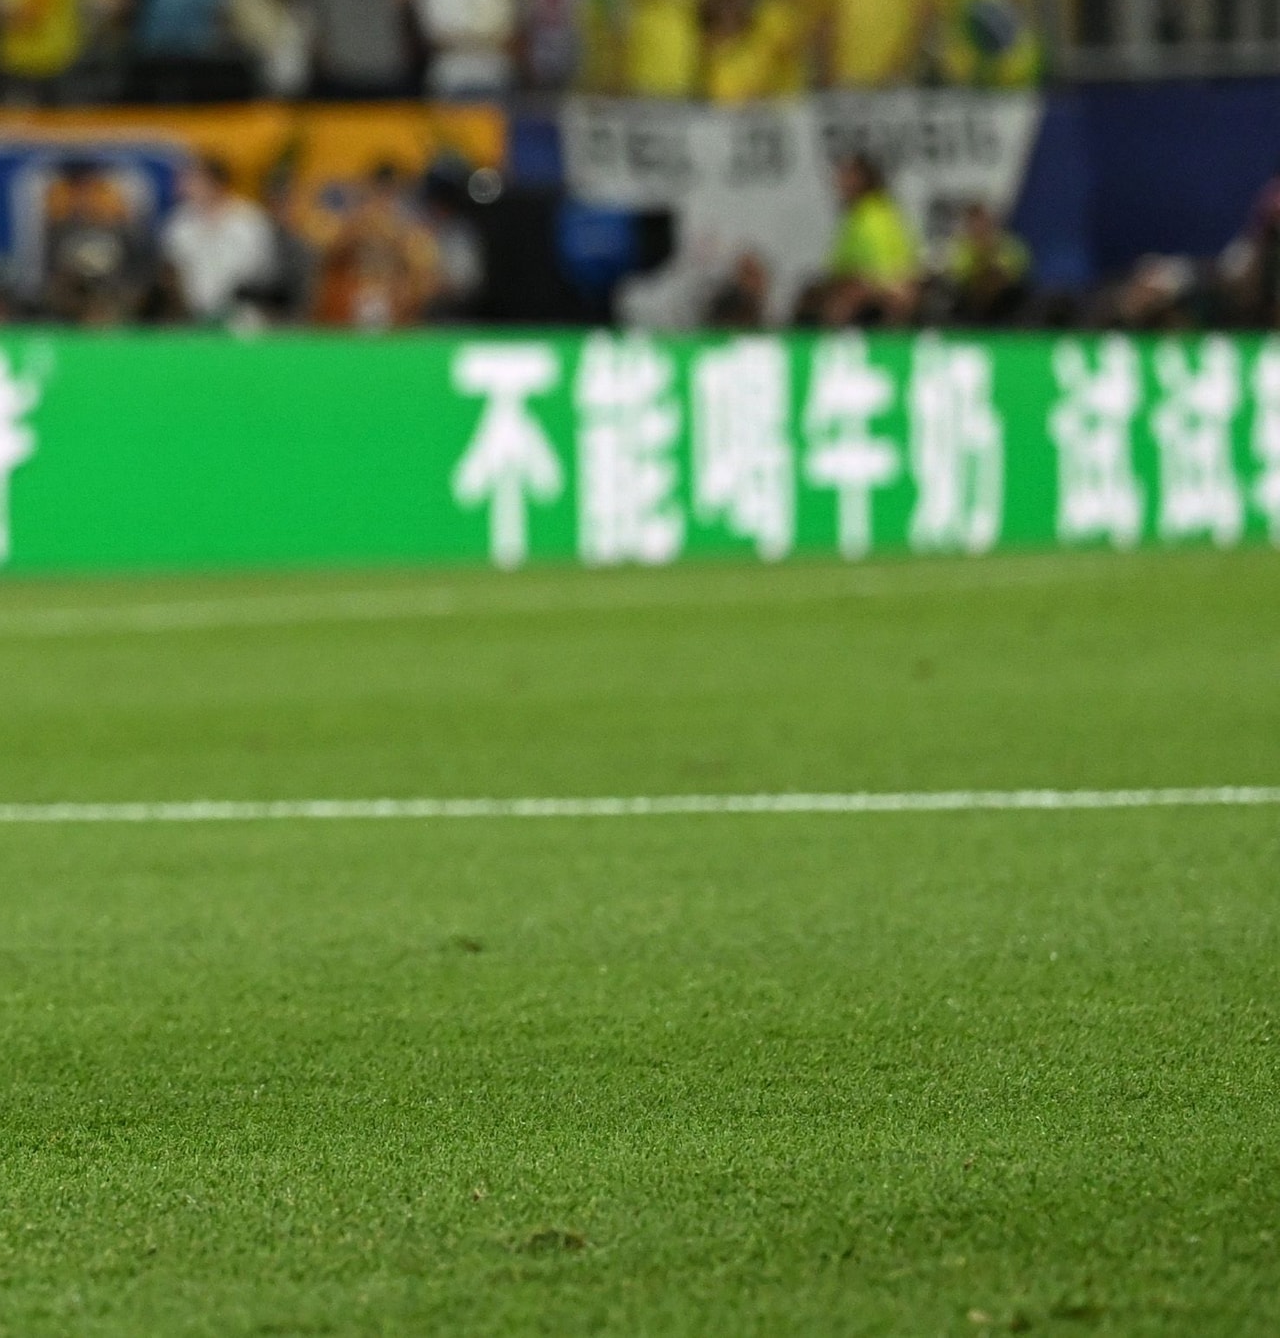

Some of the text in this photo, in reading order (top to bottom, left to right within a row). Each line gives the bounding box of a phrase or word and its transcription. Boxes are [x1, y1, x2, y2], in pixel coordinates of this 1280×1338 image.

[450, 331, 1006, 566] 不能喝牛奶
